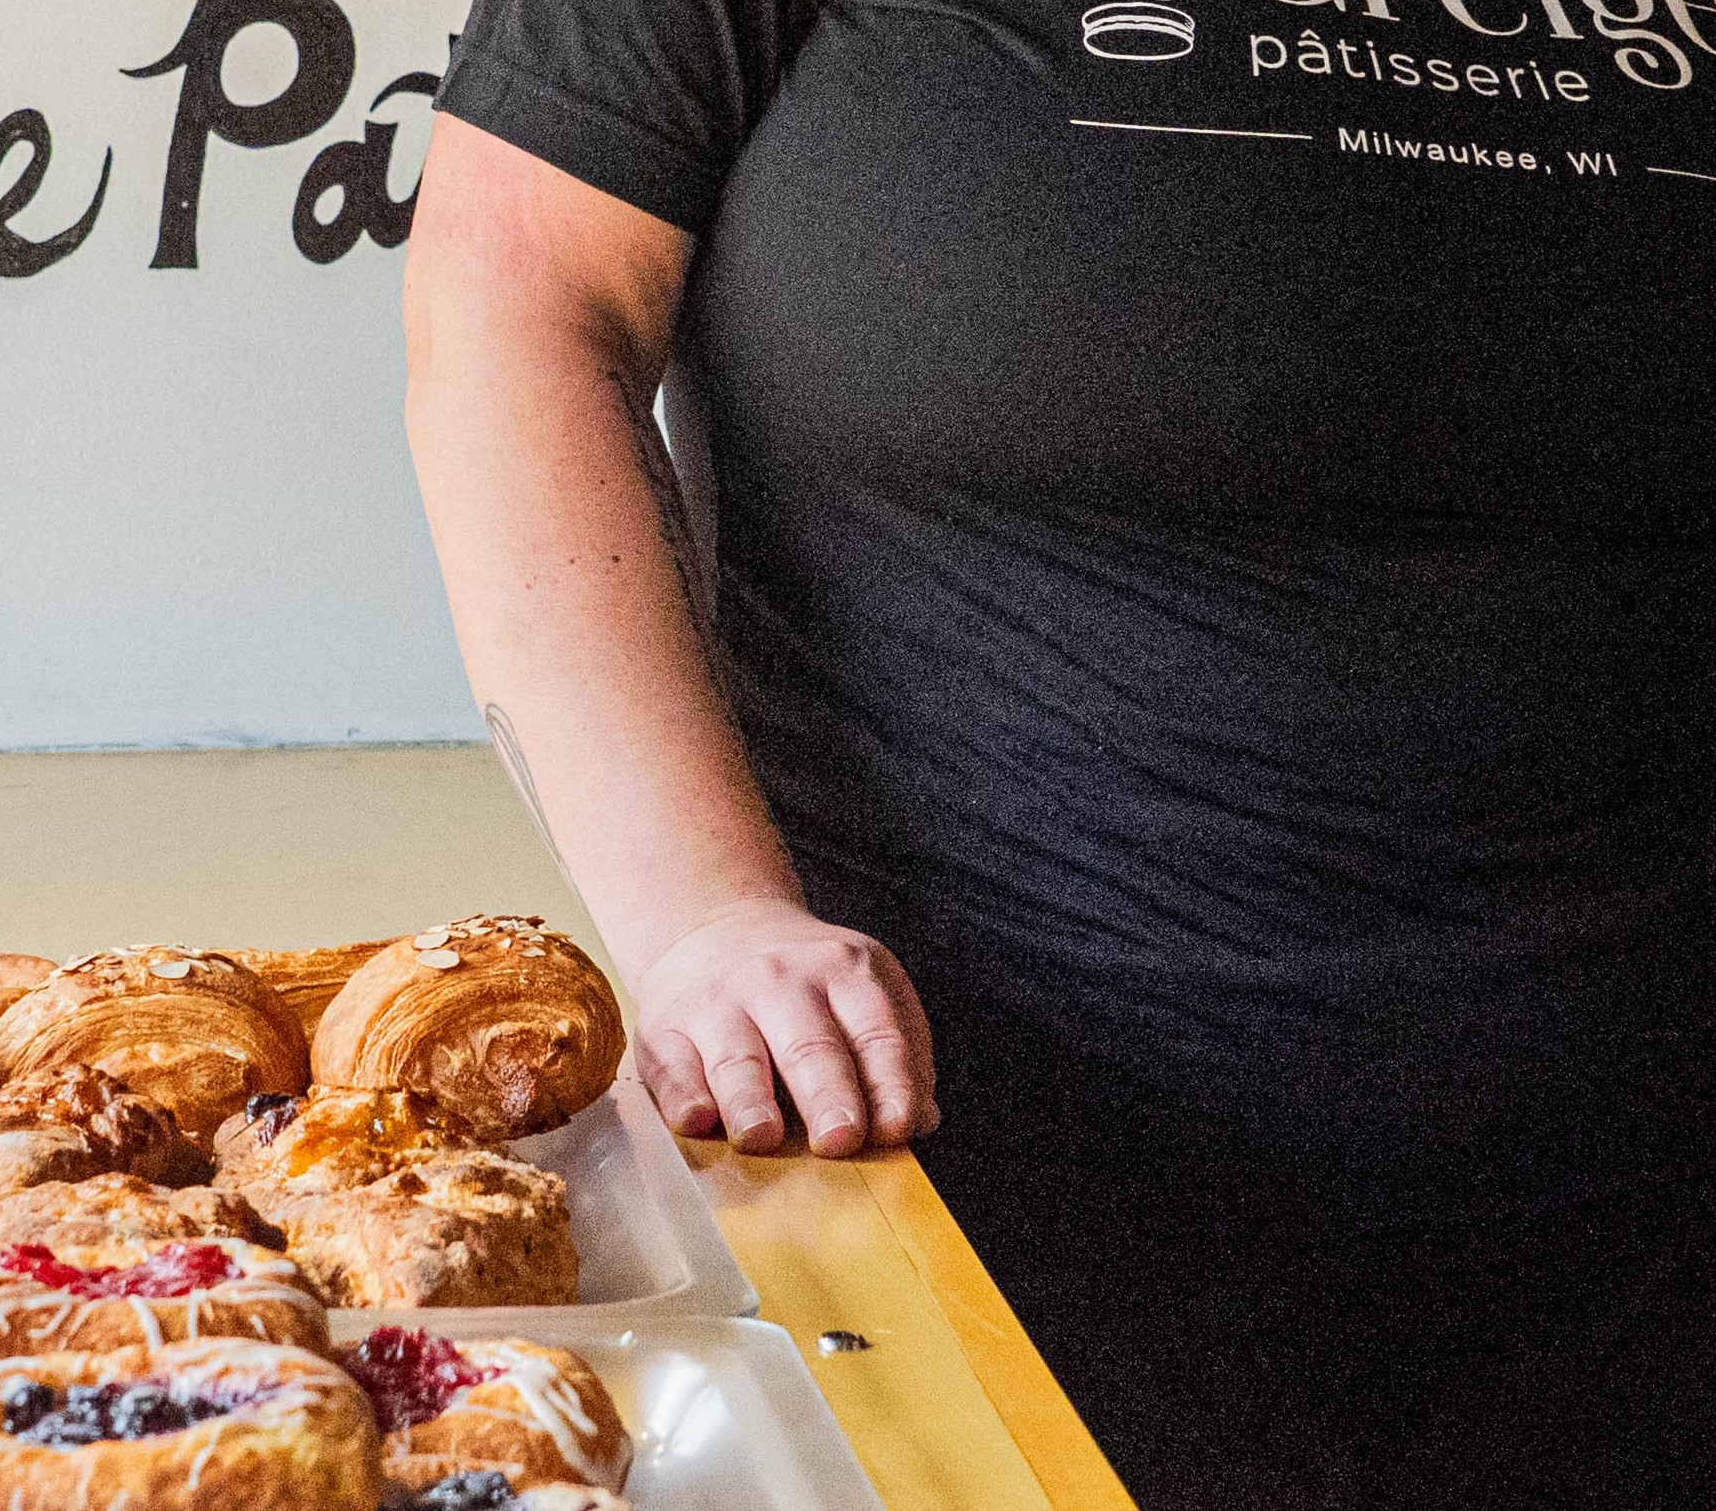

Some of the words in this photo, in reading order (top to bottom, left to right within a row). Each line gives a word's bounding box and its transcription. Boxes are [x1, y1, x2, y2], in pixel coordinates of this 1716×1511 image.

[1249, 27, 1591, 103] pâtisserie
[1338, 126, 1553, 176] Milwaukee,
[1568, 150, 1618, 178] WI
